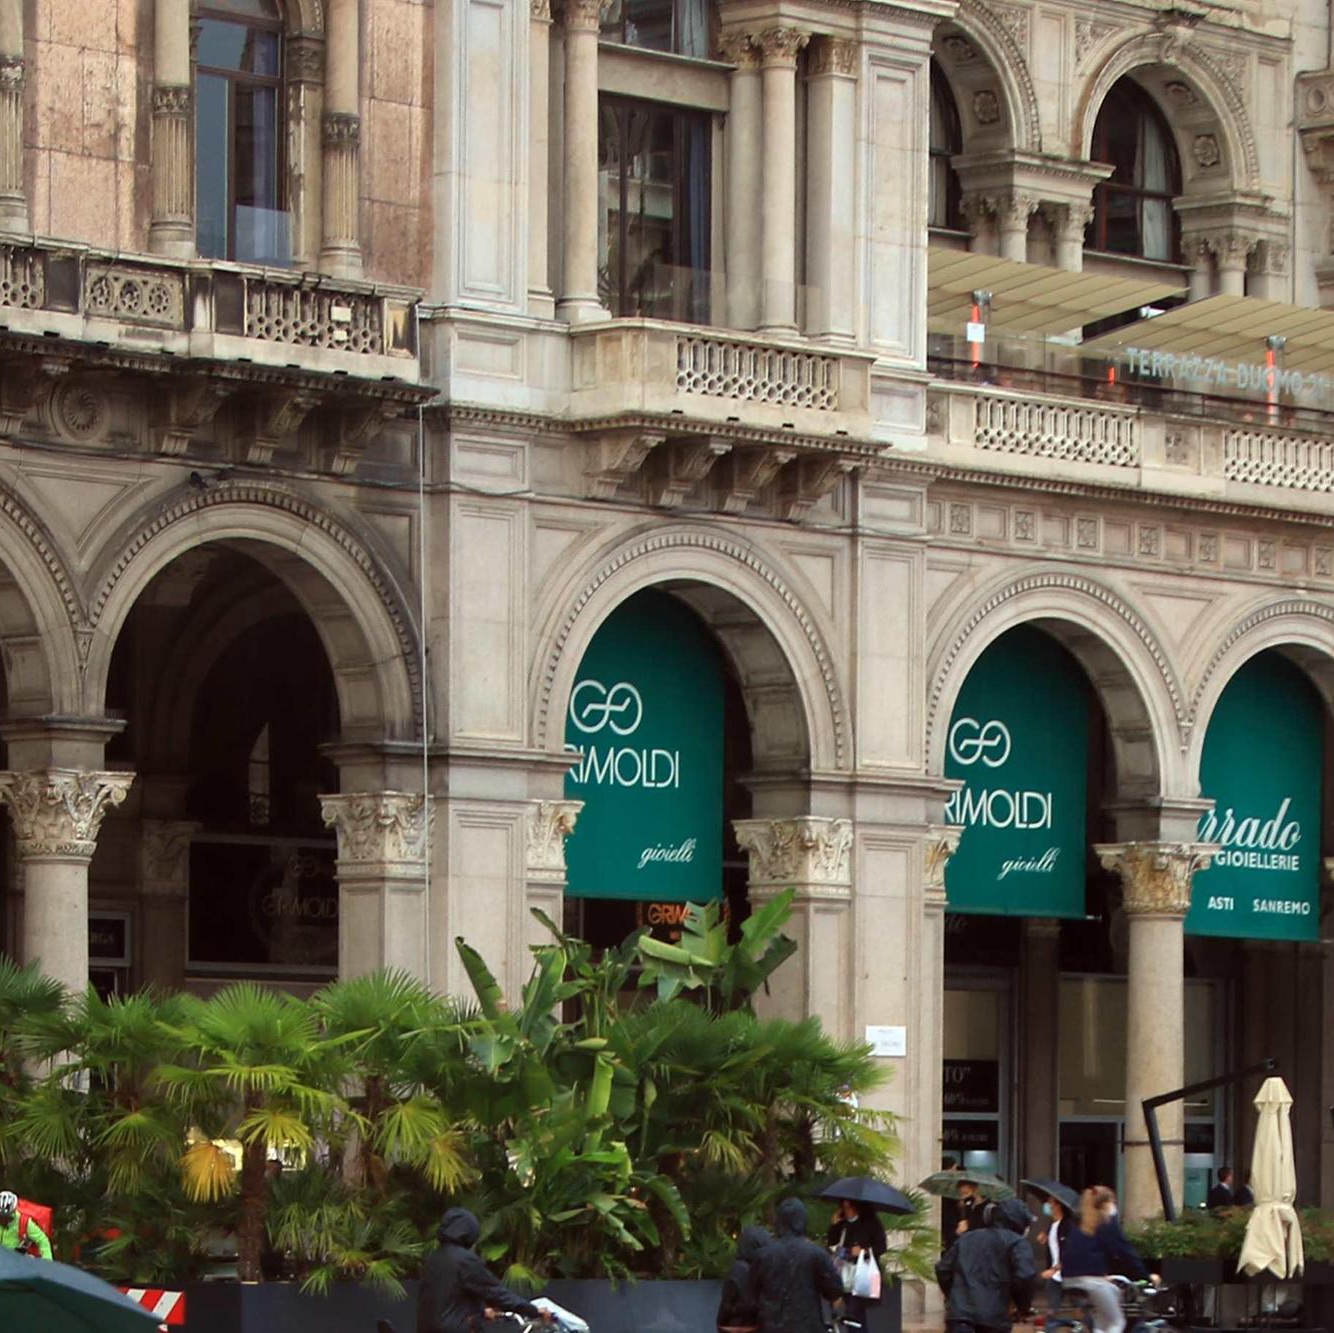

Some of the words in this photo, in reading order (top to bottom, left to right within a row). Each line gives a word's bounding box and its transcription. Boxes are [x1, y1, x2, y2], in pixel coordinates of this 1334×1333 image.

[637, 837, 697, 870] gioielli
[997, 846, 1061, 881] gioielli
[1215, 850, 1300, 872] GIOIELLERIE
[1207, 896, 1234, 911] ASTI
[1252, 897, 1311, 915] SANREMO
